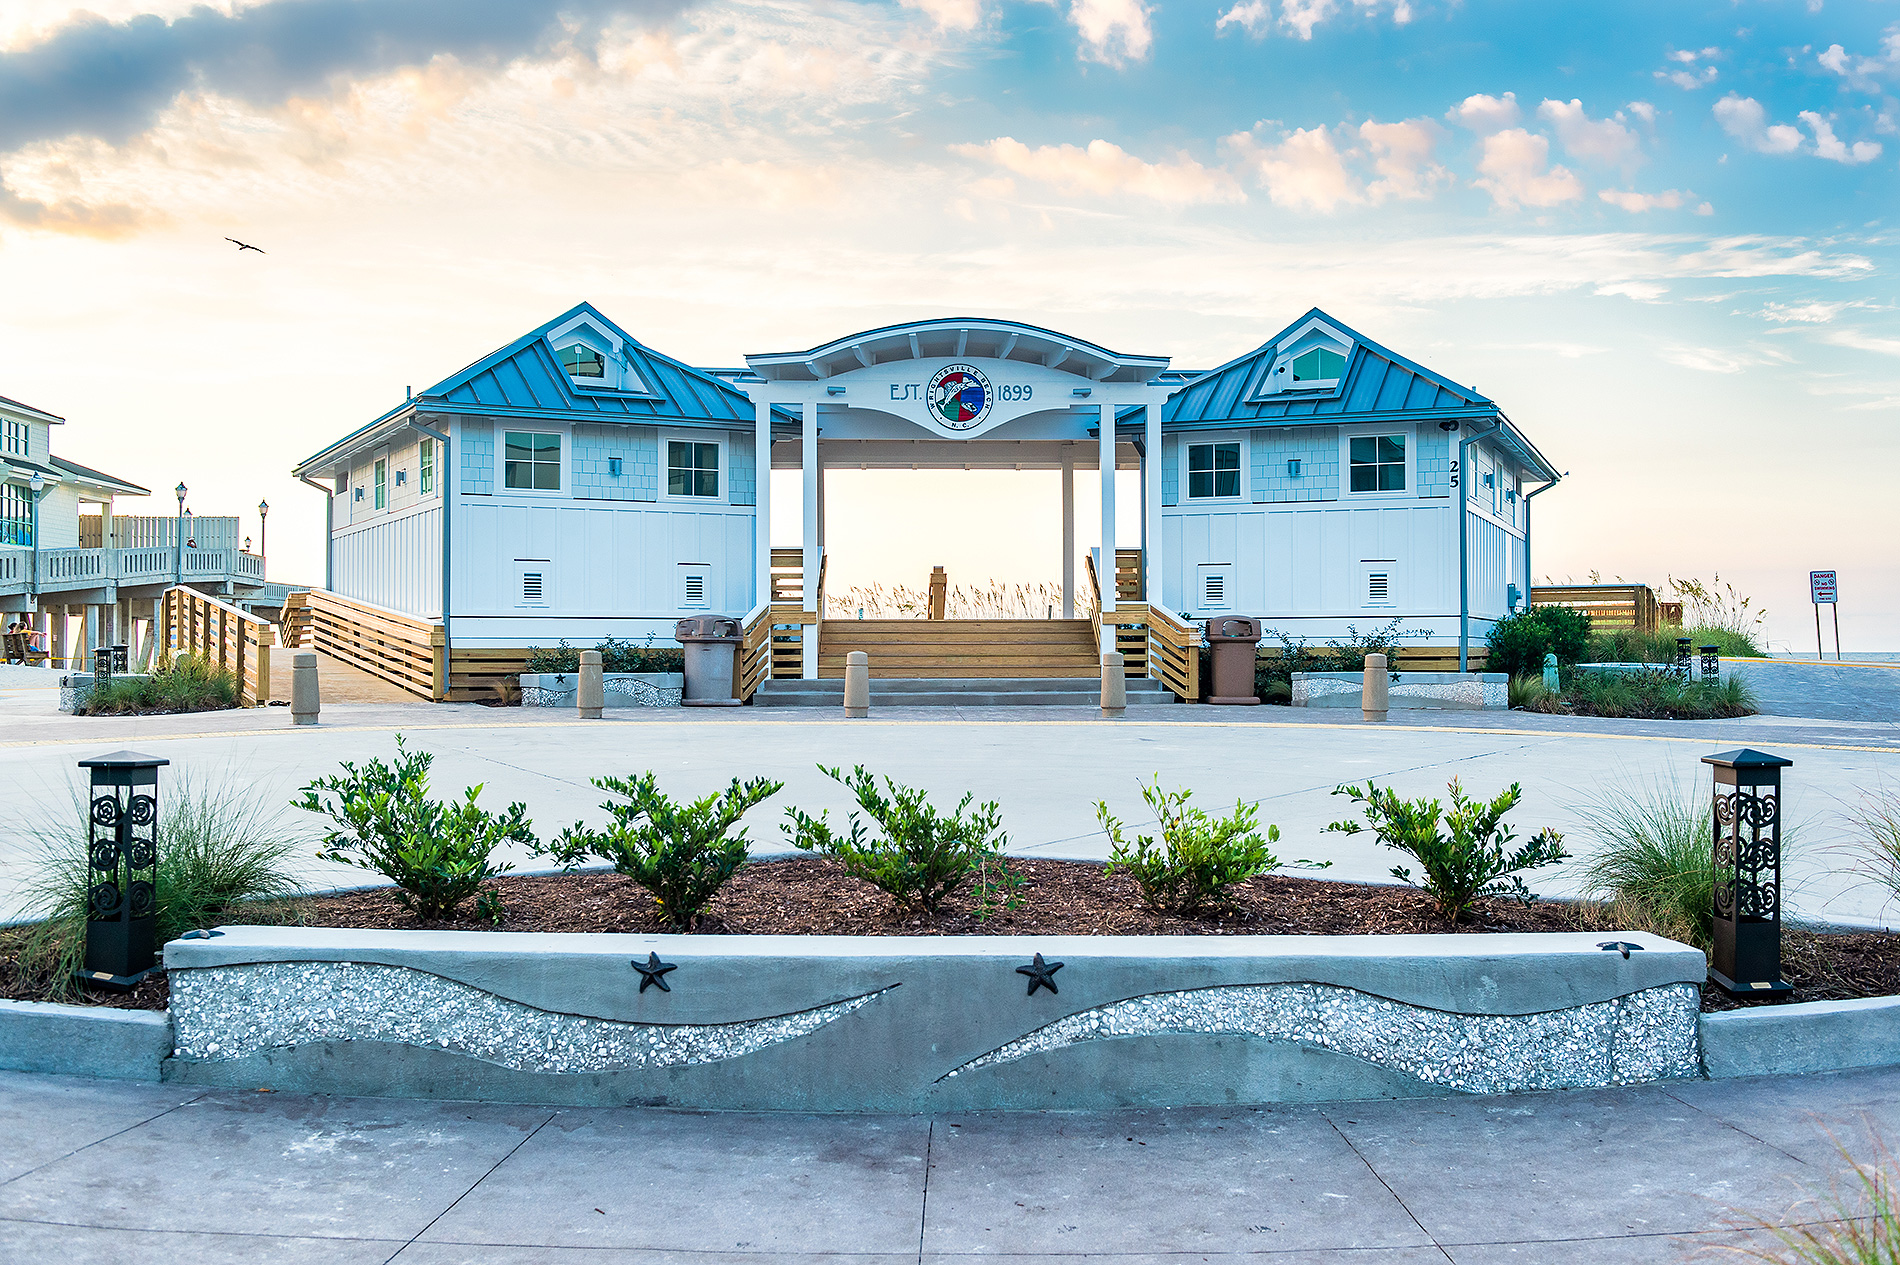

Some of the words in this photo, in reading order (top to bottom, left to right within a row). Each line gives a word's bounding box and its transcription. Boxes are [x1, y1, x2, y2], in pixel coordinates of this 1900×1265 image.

[890, 384, 922, 400] EST.
[929, 365, 979, 410] WRIGHTSVILLE
[980, 376, 991, 409] BEACH
[998, 385, 1033, 401] 1899
